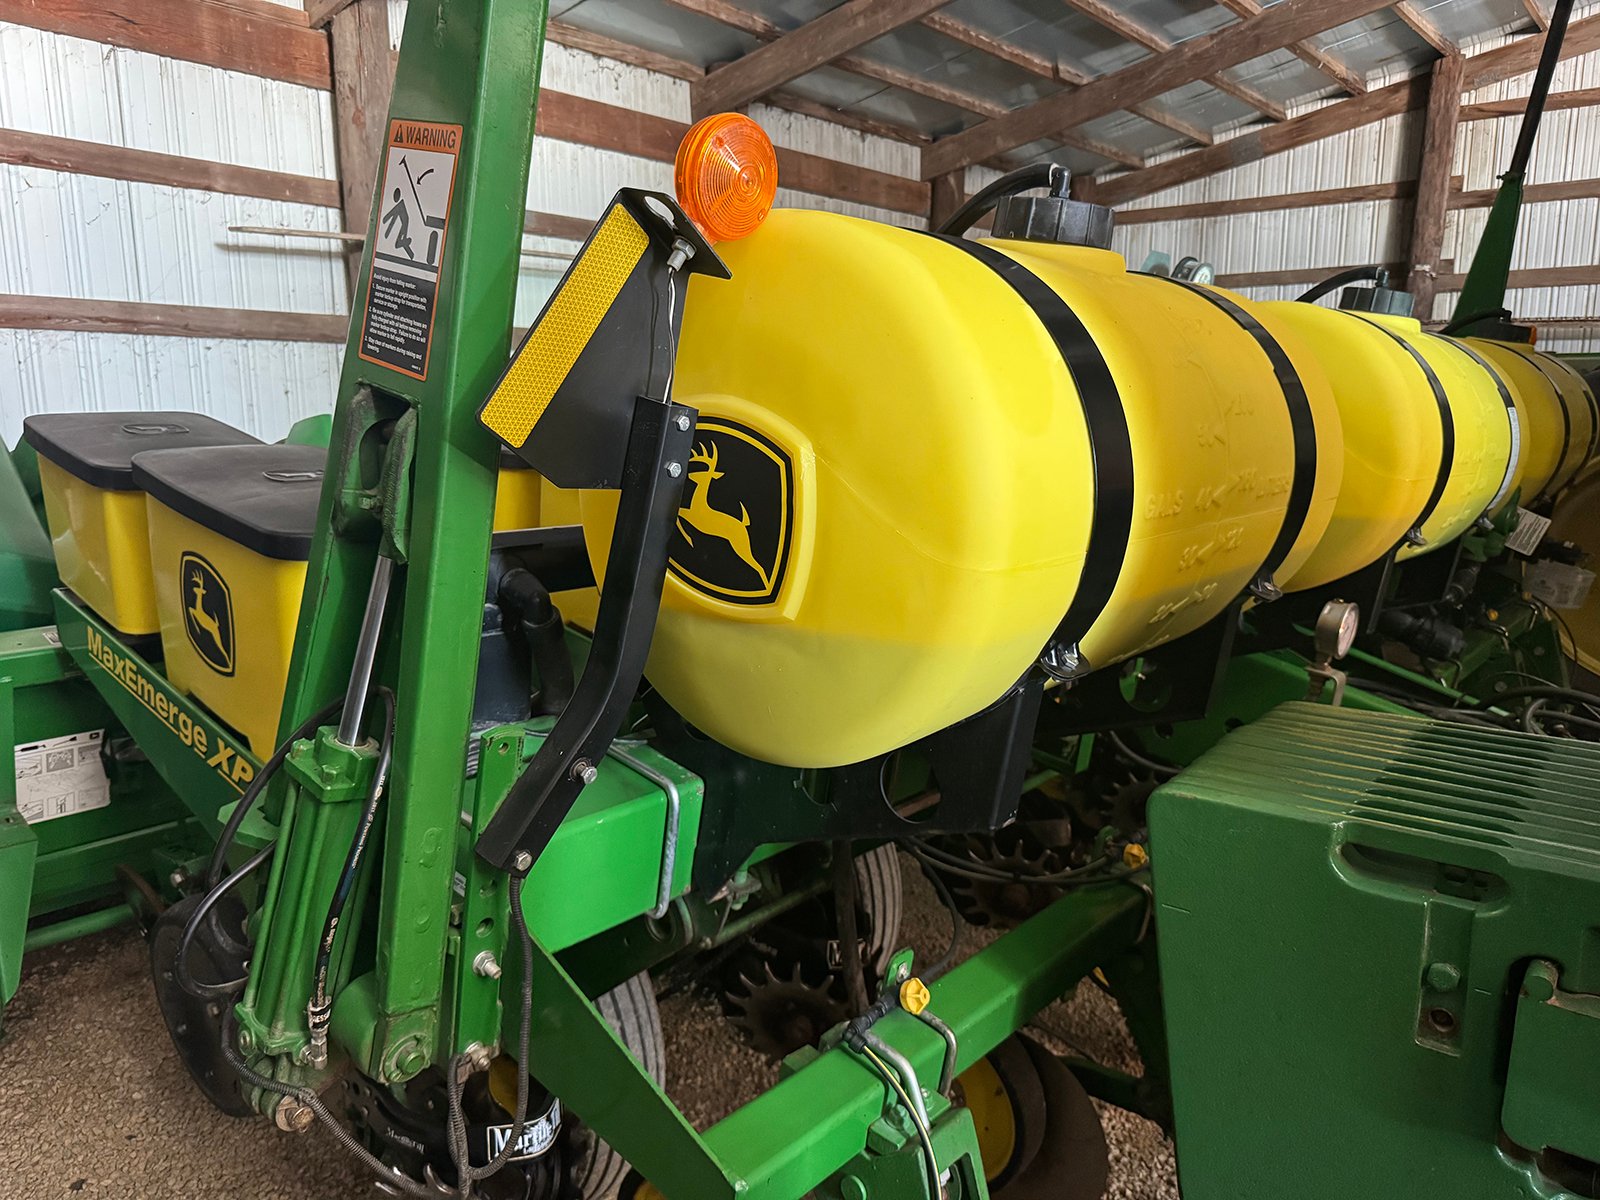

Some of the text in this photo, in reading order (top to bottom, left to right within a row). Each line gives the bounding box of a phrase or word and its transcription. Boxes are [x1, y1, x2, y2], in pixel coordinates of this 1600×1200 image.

[406, 126, 457, 149] WARNING
[87, 625, 254, 783] MaxEmerge XP
